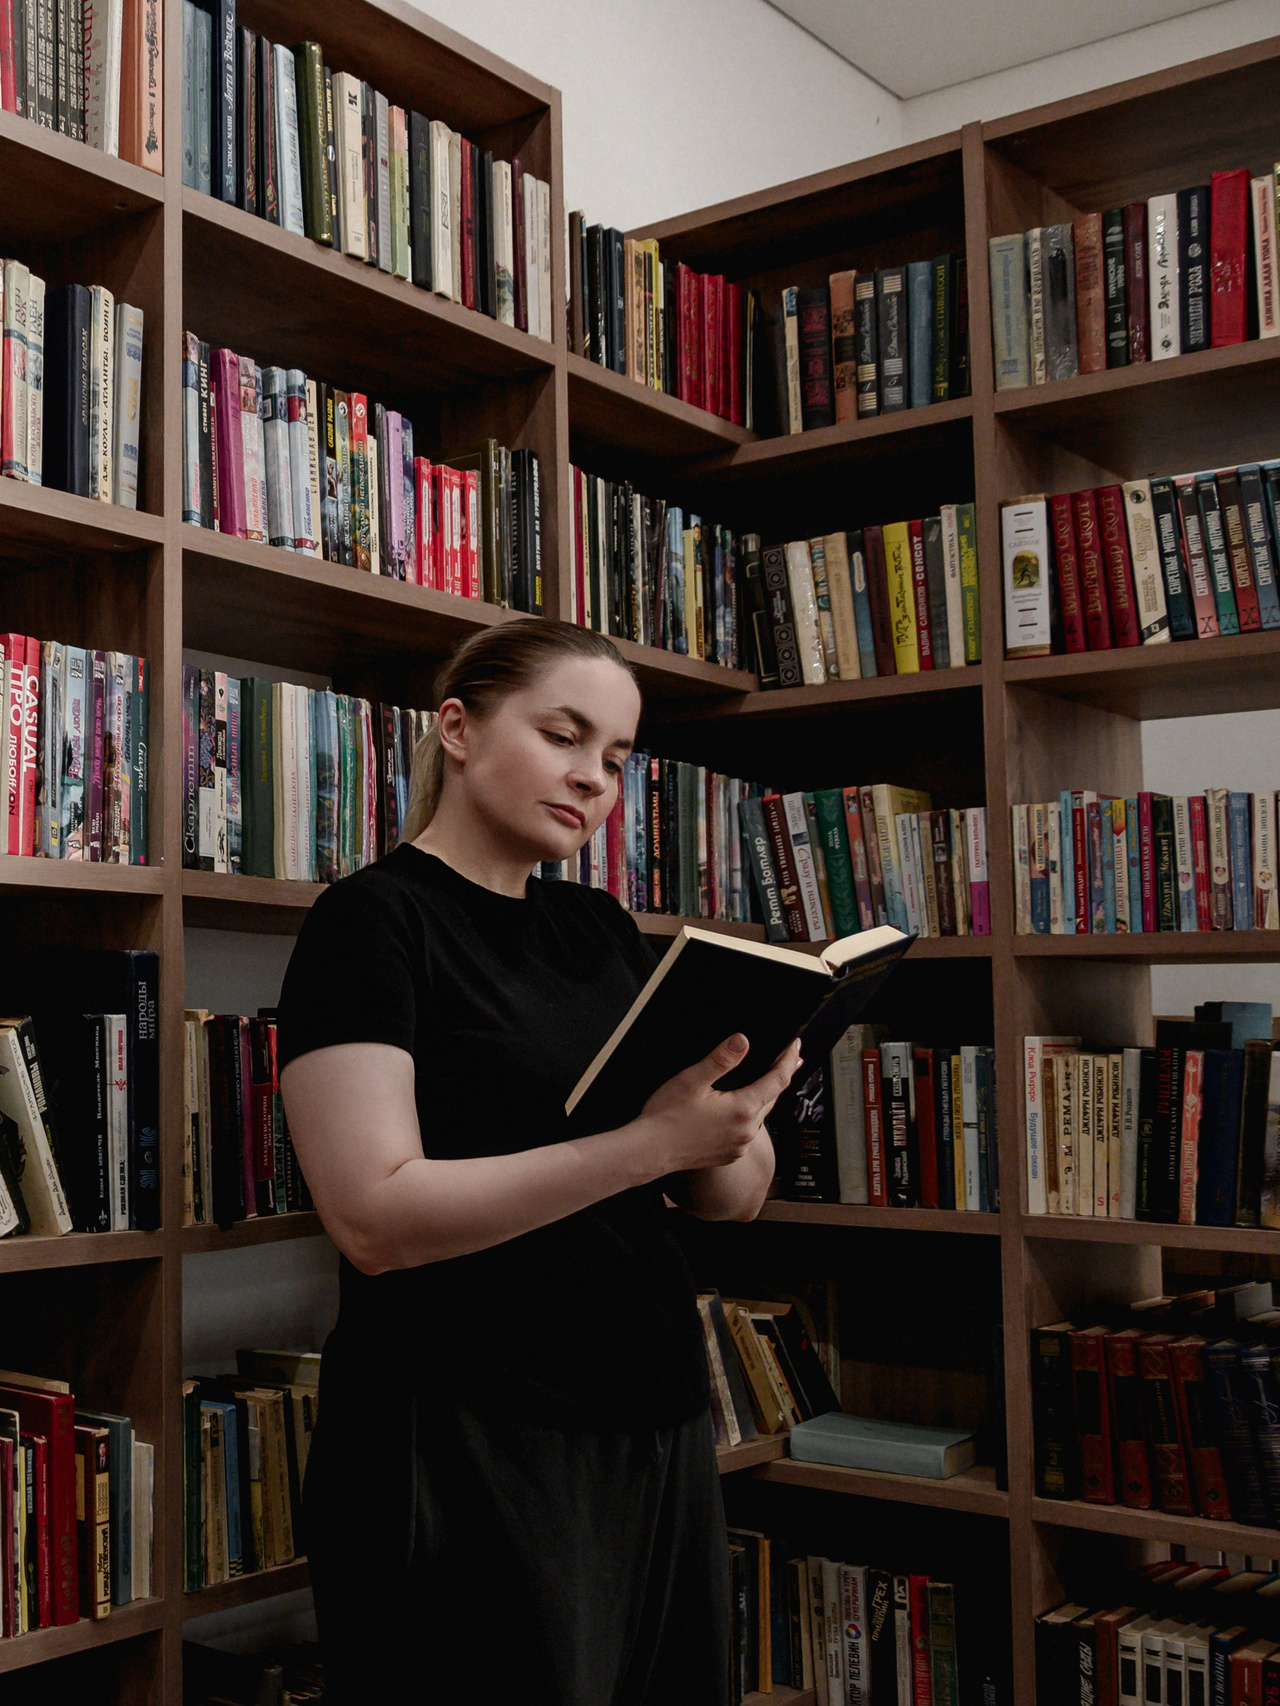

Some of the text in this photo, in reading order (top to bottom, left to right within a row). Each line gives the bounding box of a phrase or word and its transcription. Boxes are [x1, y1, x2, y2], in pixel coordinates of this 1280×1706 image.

[81, 327, 89, 371] КАРСАК
[200, 359, 209, 399] КИНГ
[127, 378, 138, 422] СНЫ
[251, 477, 260, 529] ЛУКЬЯНЕНКО
[1165, 555, 1182, 595] СЕКРЕТНЫЕ
[1192, 557, 1209, 596] СЕКРЕТНЫЕ
[1213, 552, 1230, 592] СЕКРЕТНЫЕ
[1233, 547, 1251, 588] СЕКРЕТНЫЕ
[1253, 545, 1272, 586] СЕКРЕТНЫЕ
[10, 668, 24, 726] ПРО
[23, 674, 39, 772] CASUAL
[29, 1061, 48, 1114] РОМАНОВЫ
[95, 1072, 103, 1119] Владетель
[1082, 1099, 1090, 1136] ДЖЕФРИ
[1096, 1107, 1104, 1143] ДЖЕФРИ
[847, 1642, 861, 1681] ПЕЛЕВИН
